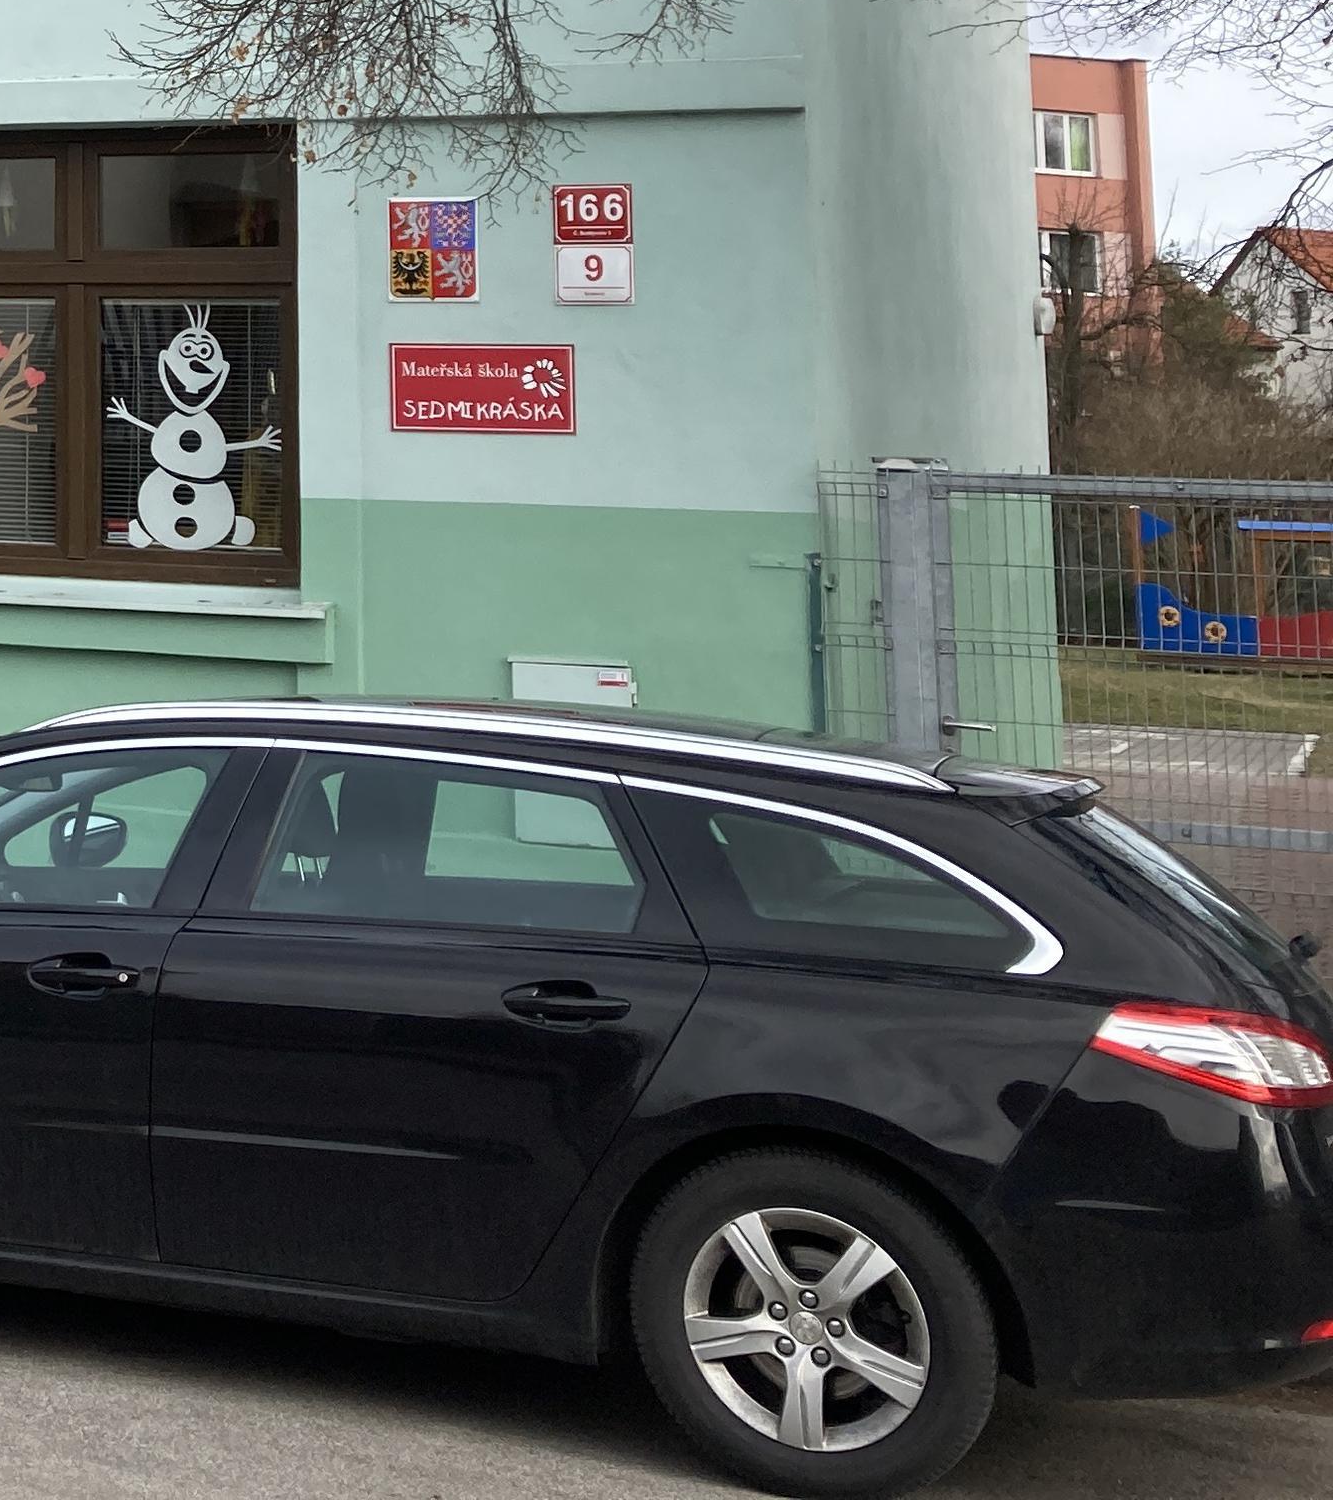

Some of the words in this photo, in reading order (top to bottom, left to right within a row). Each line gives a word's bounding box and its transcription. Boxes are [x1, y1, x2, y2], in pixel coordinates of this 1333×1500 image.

[560, 193, 624, 222] 166
[584, 254, 604, 282] 9
[401, 361, 473, 378] Mateřská
[478, 363, 519, 379] škola
[403, 396, 565, 422] SEDMIKRÁSKA
